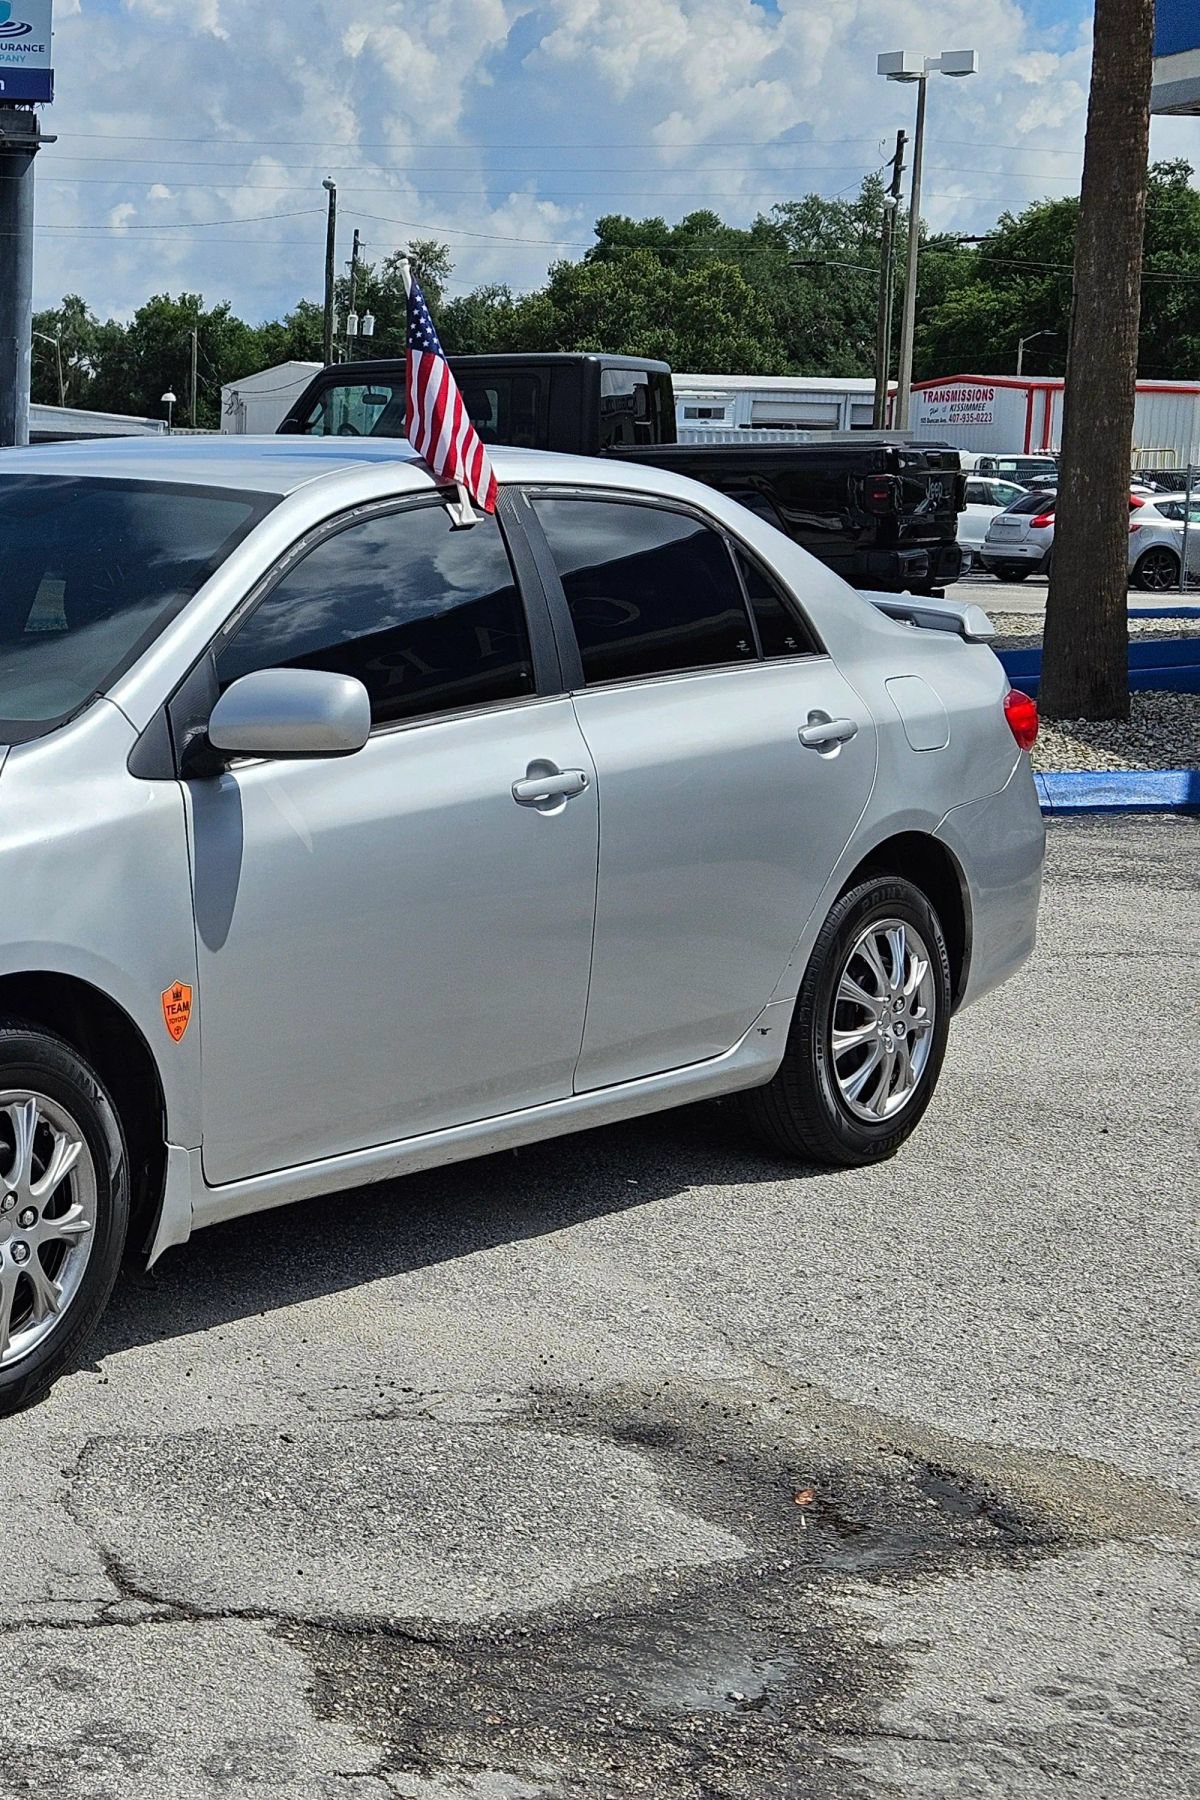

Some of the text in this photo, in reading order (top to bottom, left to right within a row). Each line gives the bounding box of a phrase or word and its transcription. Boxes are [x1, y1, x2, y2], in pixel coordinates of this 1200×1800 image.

[922, 388, 995, 404] TRANSMISSIONS
[949, 403, 987, 412] KISSIMMEE
[949, 412, 993, 424] 407-935-0223
[925, 476, 943, 502] Jeep
[165, 1000, 190, 1016] TEAM
[168, 1015, 188, 1025] TOYOTA
